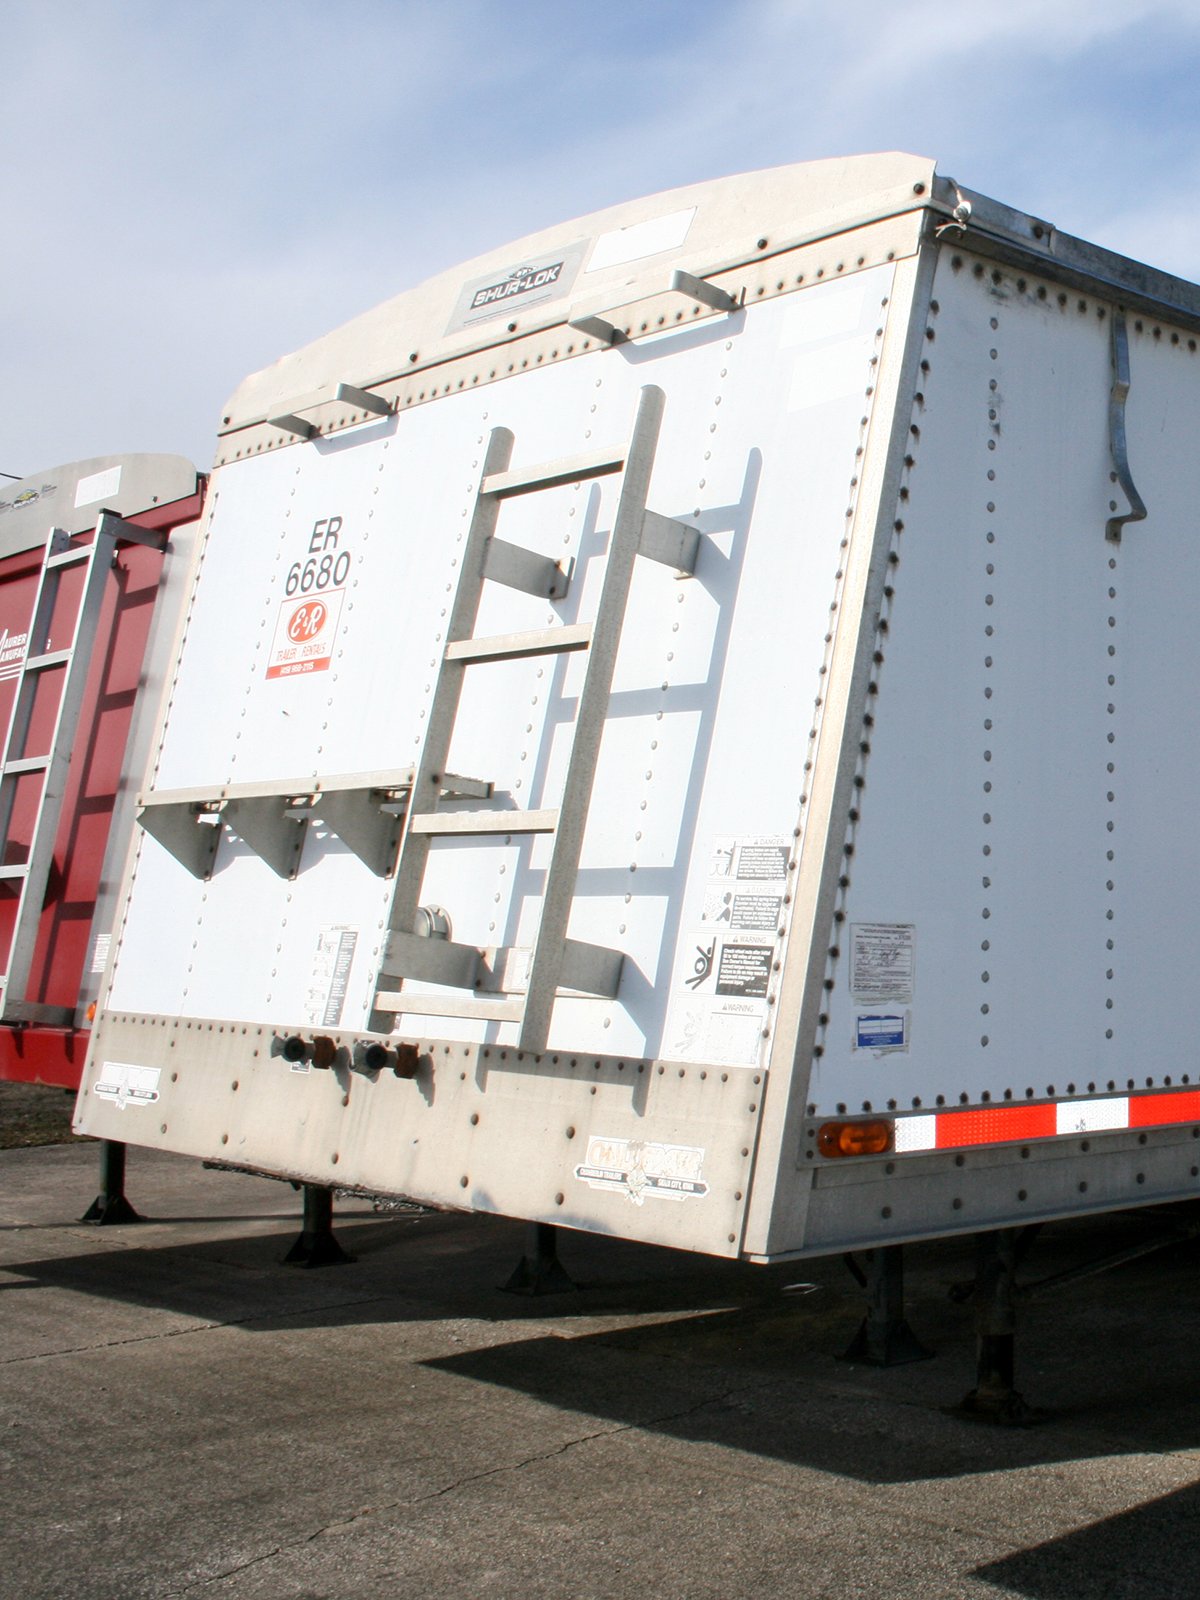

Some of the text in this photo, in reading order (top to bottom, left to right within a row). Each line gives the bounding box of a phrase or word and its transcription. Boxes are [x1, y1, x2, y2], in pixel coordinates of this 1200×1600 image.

[474, 265, 561, 306] SHUR-LOK
[308, 515, 343, 554] ER
[285, 550, 351, 596] 6680
[760, 838, 785, 846] DANGER
[740, 936, 767, 944] WARNING
[727, 1002, 754, 1012] WARNING
